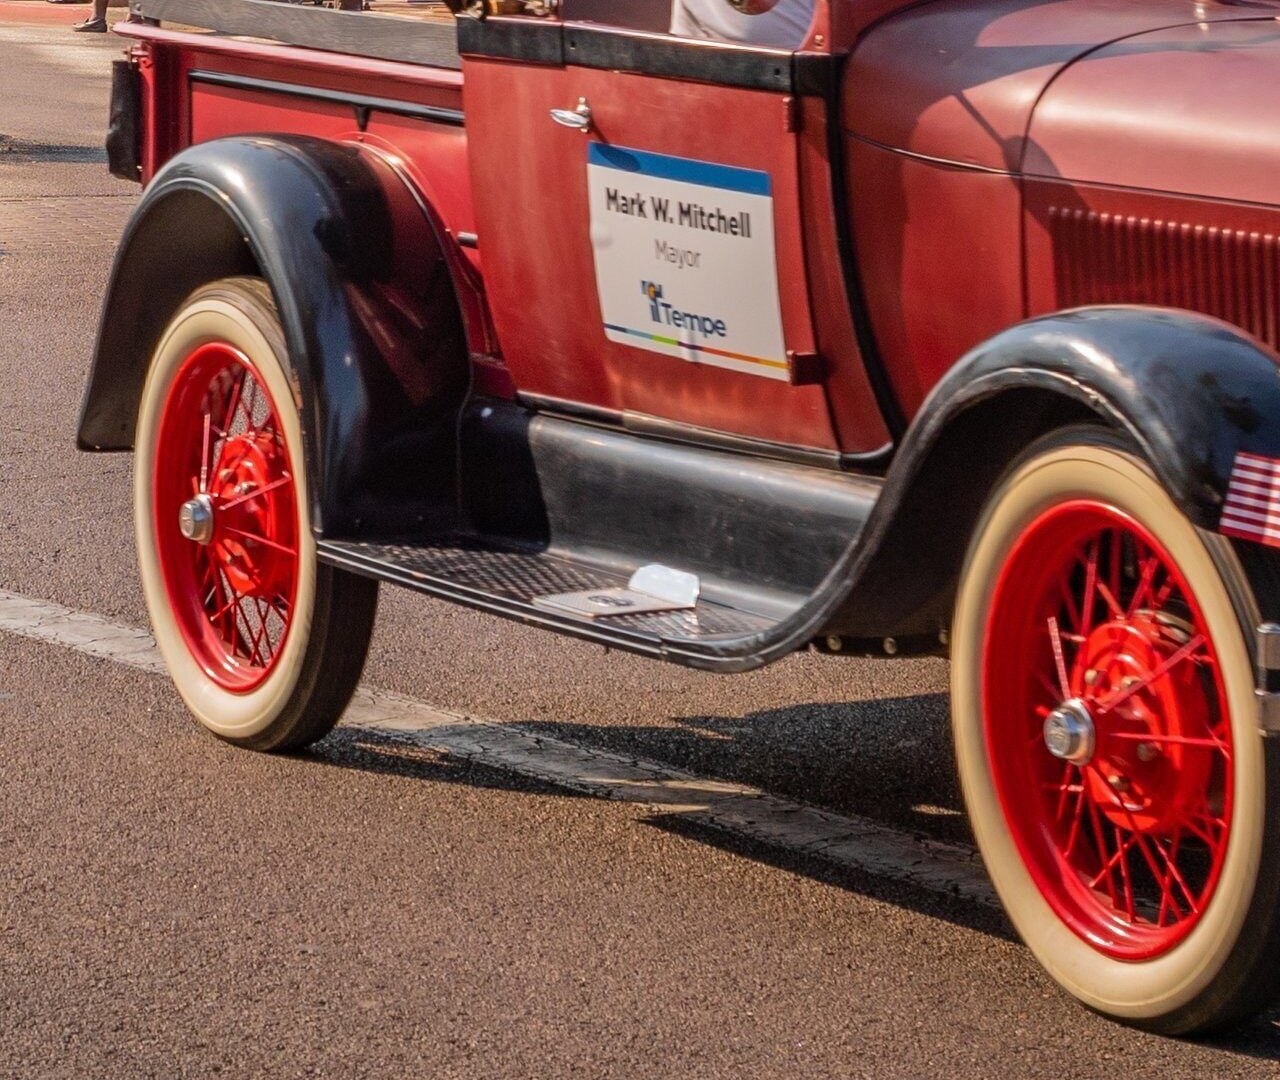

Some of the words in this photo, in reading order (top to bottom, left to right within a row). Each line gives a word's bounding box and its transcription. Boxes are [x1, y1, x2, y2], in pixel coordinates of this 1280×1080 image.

[605, 186, 648, 219] Mark
[650, 195, 674, 224] W.
[678, 201, 752, 239] Mitchell
[654, 238, 702, 270] Mayor
[661, 302, 728, 339] Tempe
